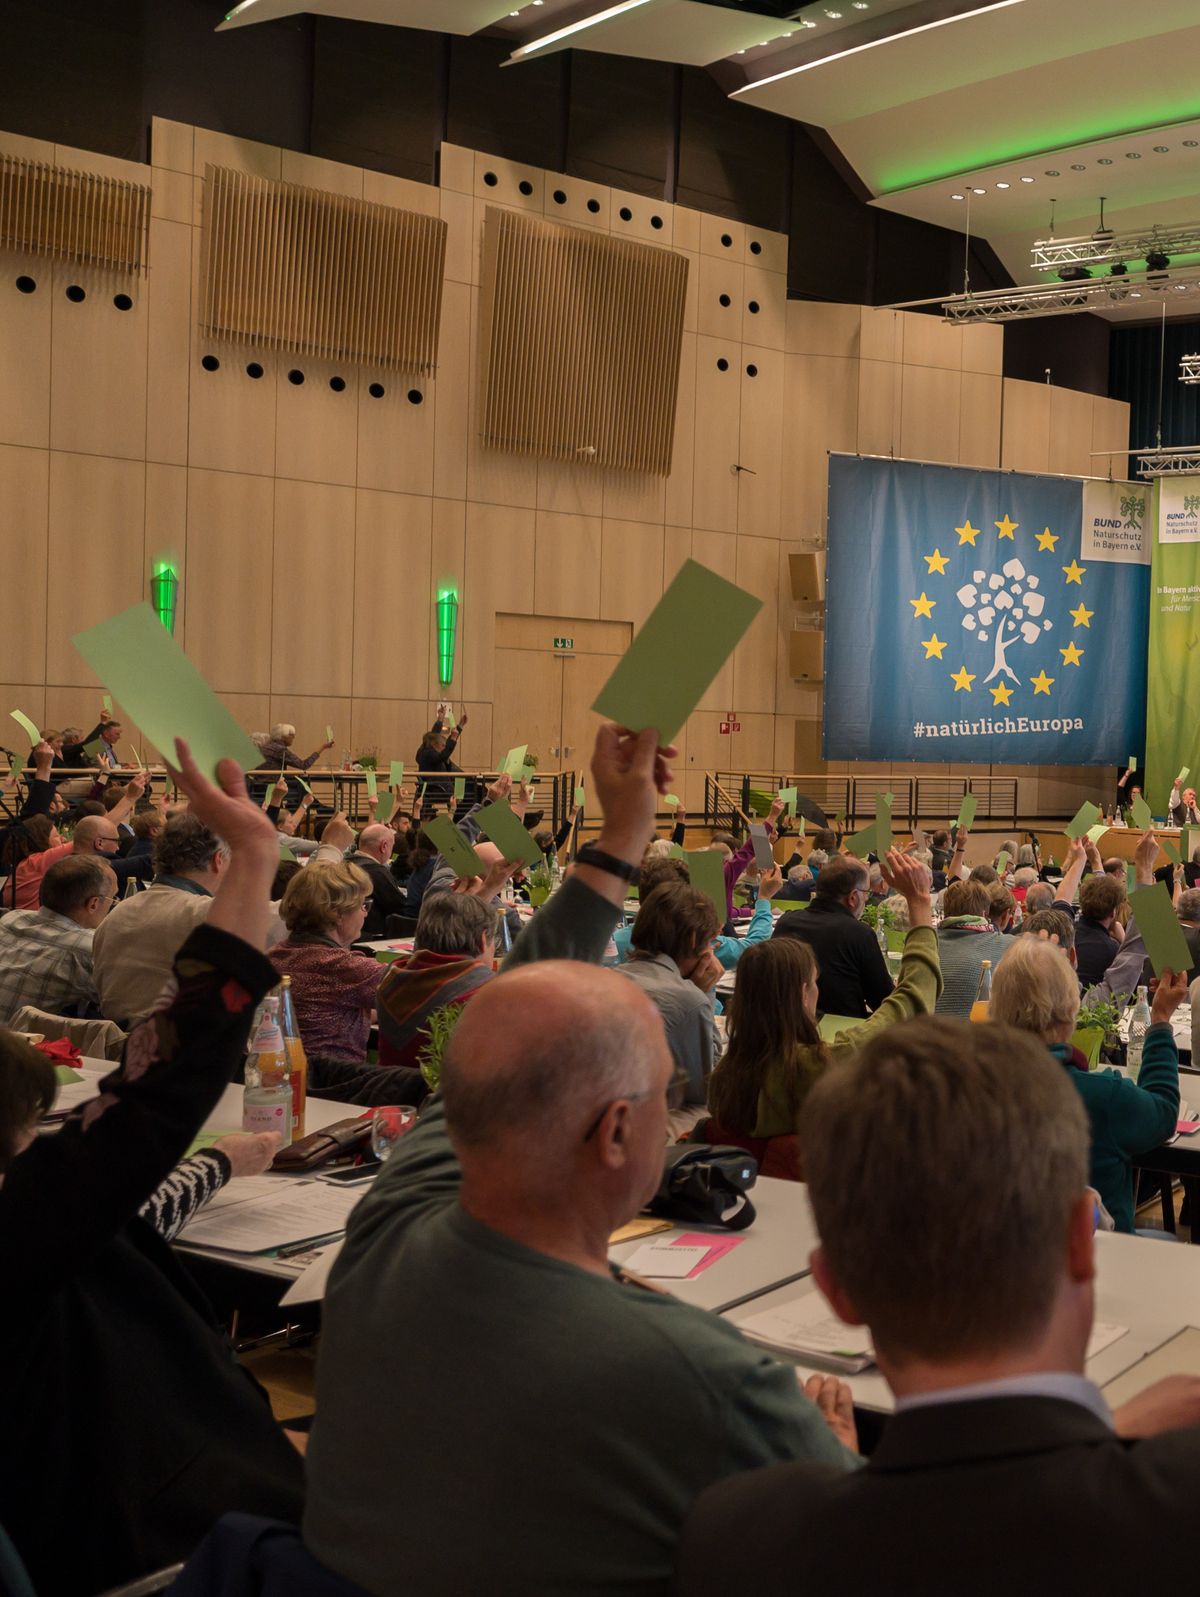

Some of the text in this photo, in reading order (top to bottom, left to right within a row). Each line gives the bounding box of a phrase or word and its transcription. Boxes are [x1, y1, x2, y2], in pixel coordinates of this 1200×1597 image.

[1094, 518, 1122, 528] BUND
[1093, 529, 1142, 541] Naturschutz
[1172, 527, 1189, 535] Bayern
[1093, 540, 1142, 551] in Bayern e.V.
[1163, 586, 1187, 595] Bayern
[913, 716, 1084, 738] #natürlichEuropa
